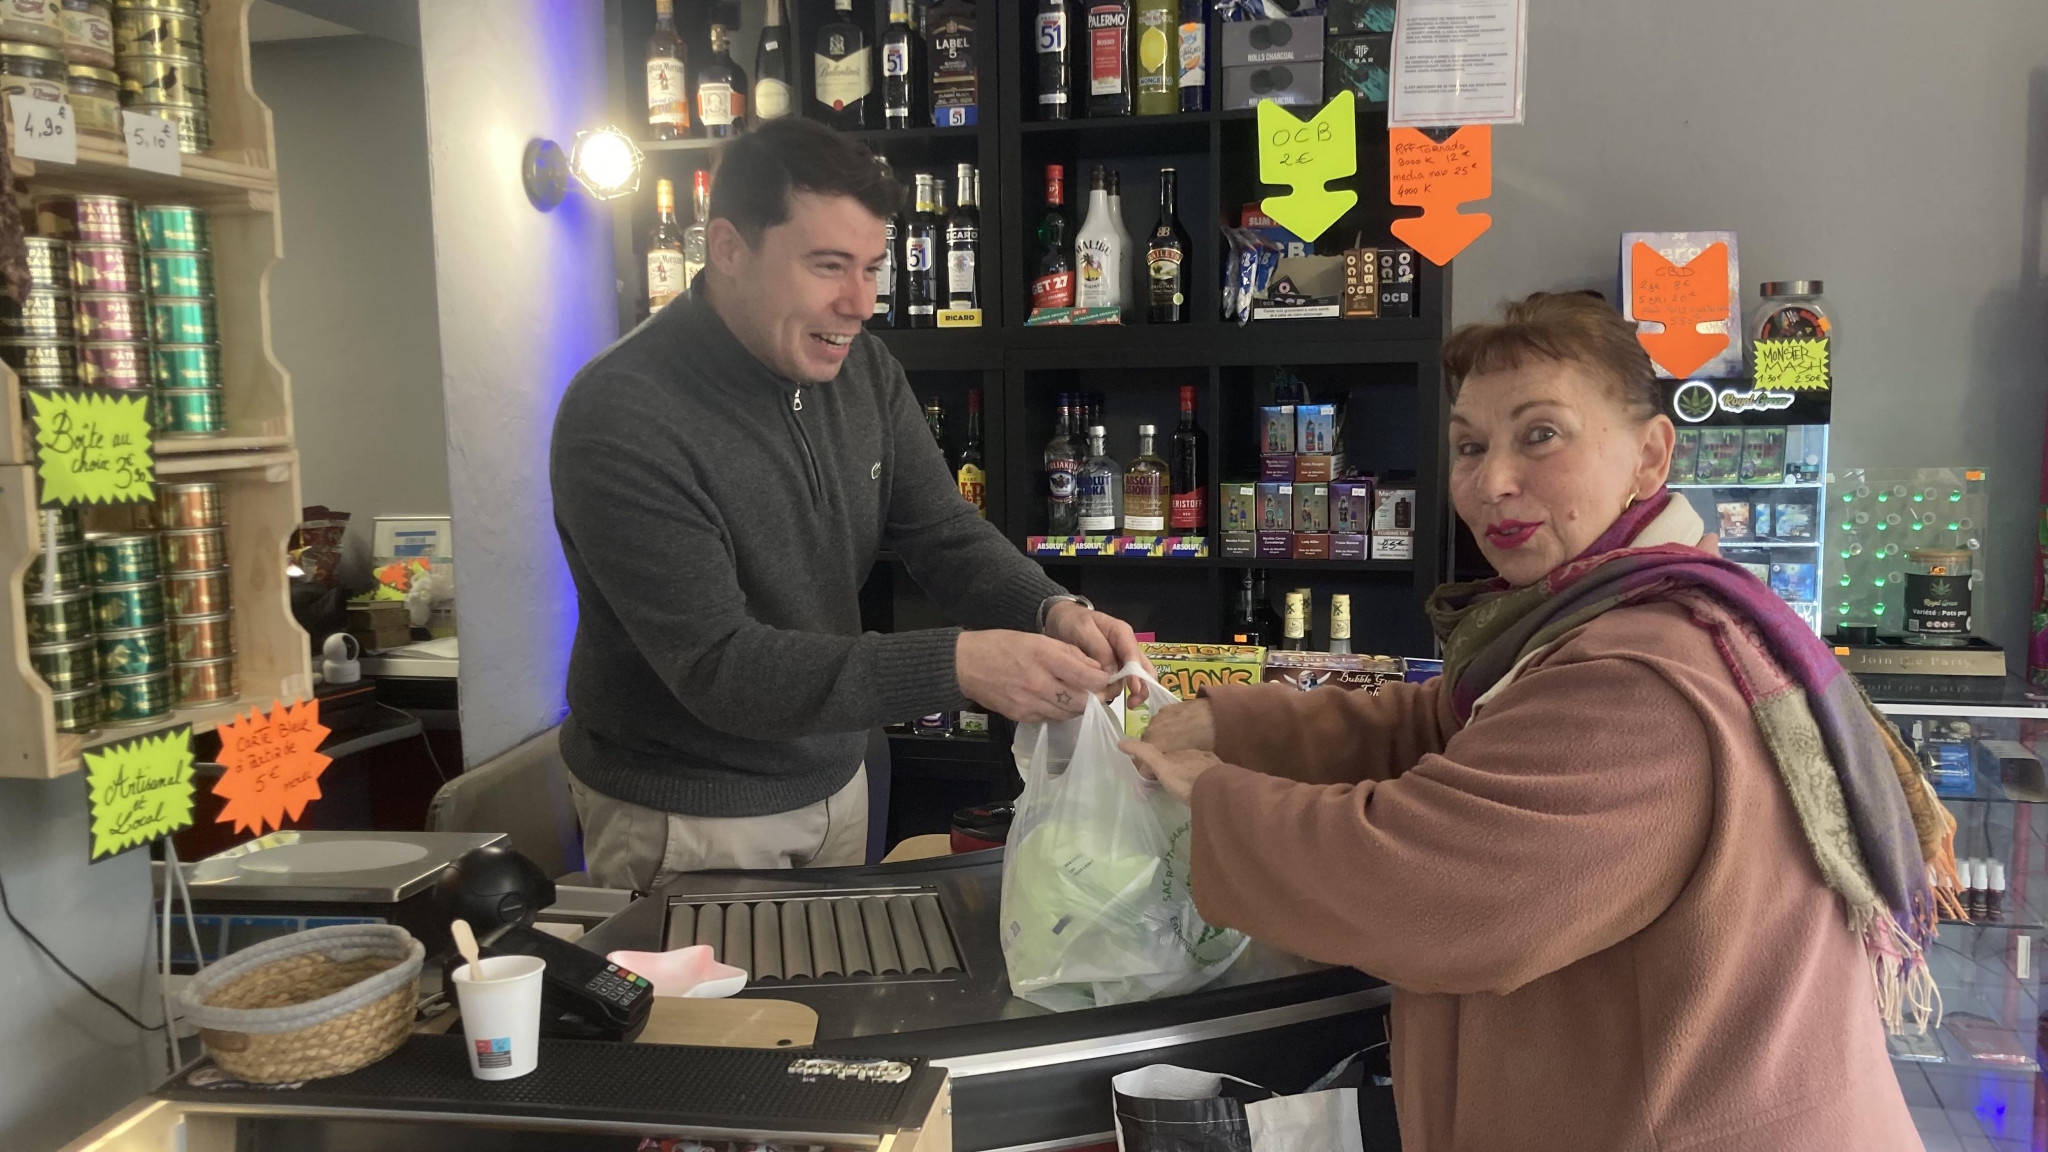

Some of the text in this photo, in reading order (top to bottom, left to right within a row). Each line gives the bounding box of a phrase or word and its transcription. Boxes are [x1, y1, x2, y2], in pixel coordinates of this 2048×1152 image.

[1088, 13, 1125, 28] PALERMO
[936, 37, 970, 50] LABEL
[1041, 25, 1062, 49] 51
[948, 49, 957, 59] 5
[1247, 51, 1295, 62] ROLLS CHARCOAL
[886, 52, 904, 73] 51
[952, 113, 962, 124] 51
[1272, 121, 1332, 147] OCB
[909, 247, 926, 268] 51
[1363, 252, 1374, 284] OCB
[1032, 275, 1069, 295] GET 27
[1347, 286, 1374, 295] OCB
[1381, 292, 1409, 303] OCB
[1763, 345, 1816, 363] MONSTER
[1765, 357, 1822, 375] MASH
[1722, 391, 1791, 407] Royal Green
[1860, 654, 1892, 665] Join
[1337, 671, 1372, 683] Bubble
[1162, 879, 1172, 902] SAC
